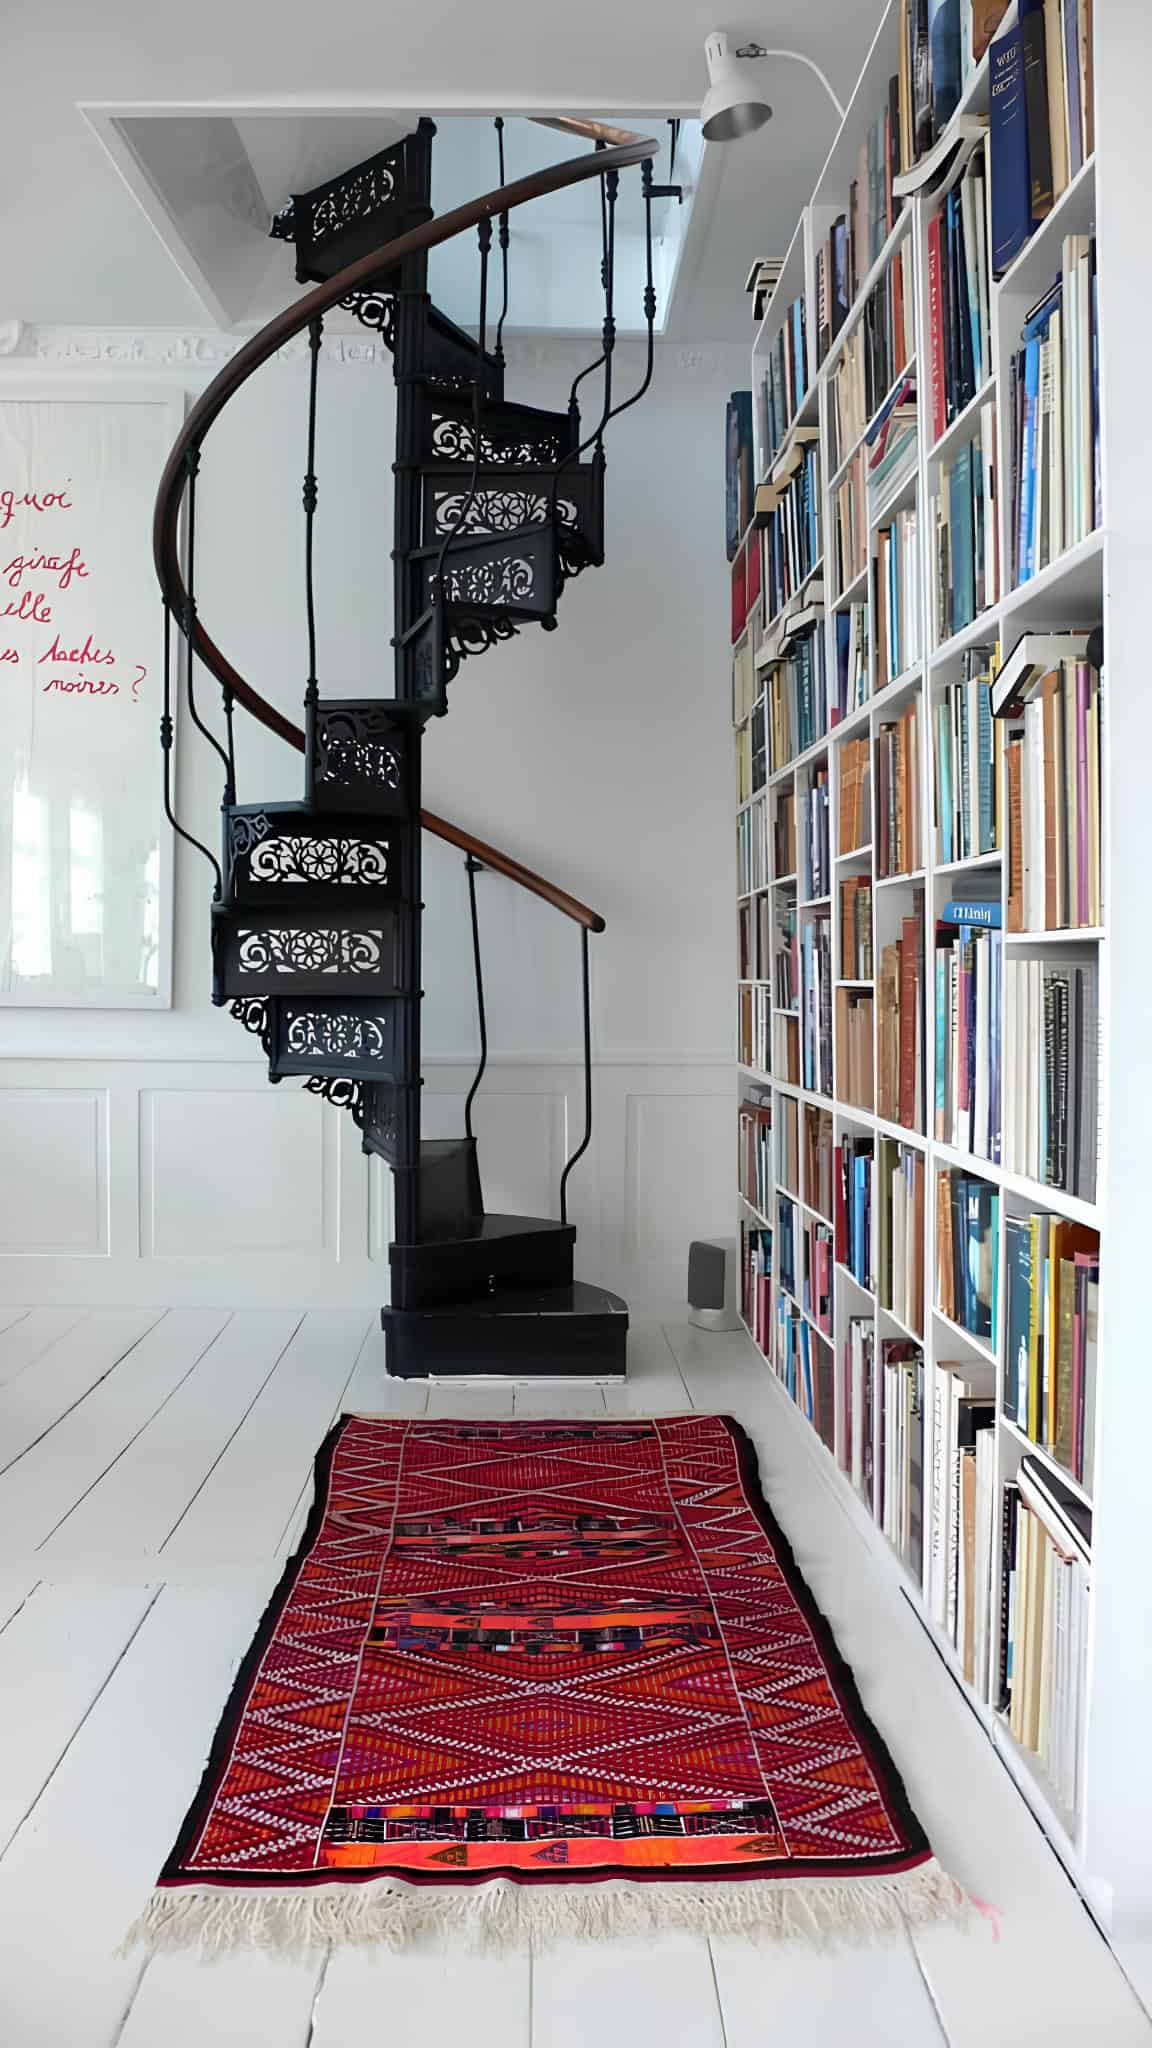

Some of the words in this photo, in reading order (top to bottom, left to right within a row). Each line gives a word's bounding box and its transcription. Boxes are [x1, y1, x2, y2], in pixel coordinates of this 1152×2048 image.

[2, 547, 89, 589] girafe
[37, 633, 116, 665] taches
[43, 673, 119, 695] noires
